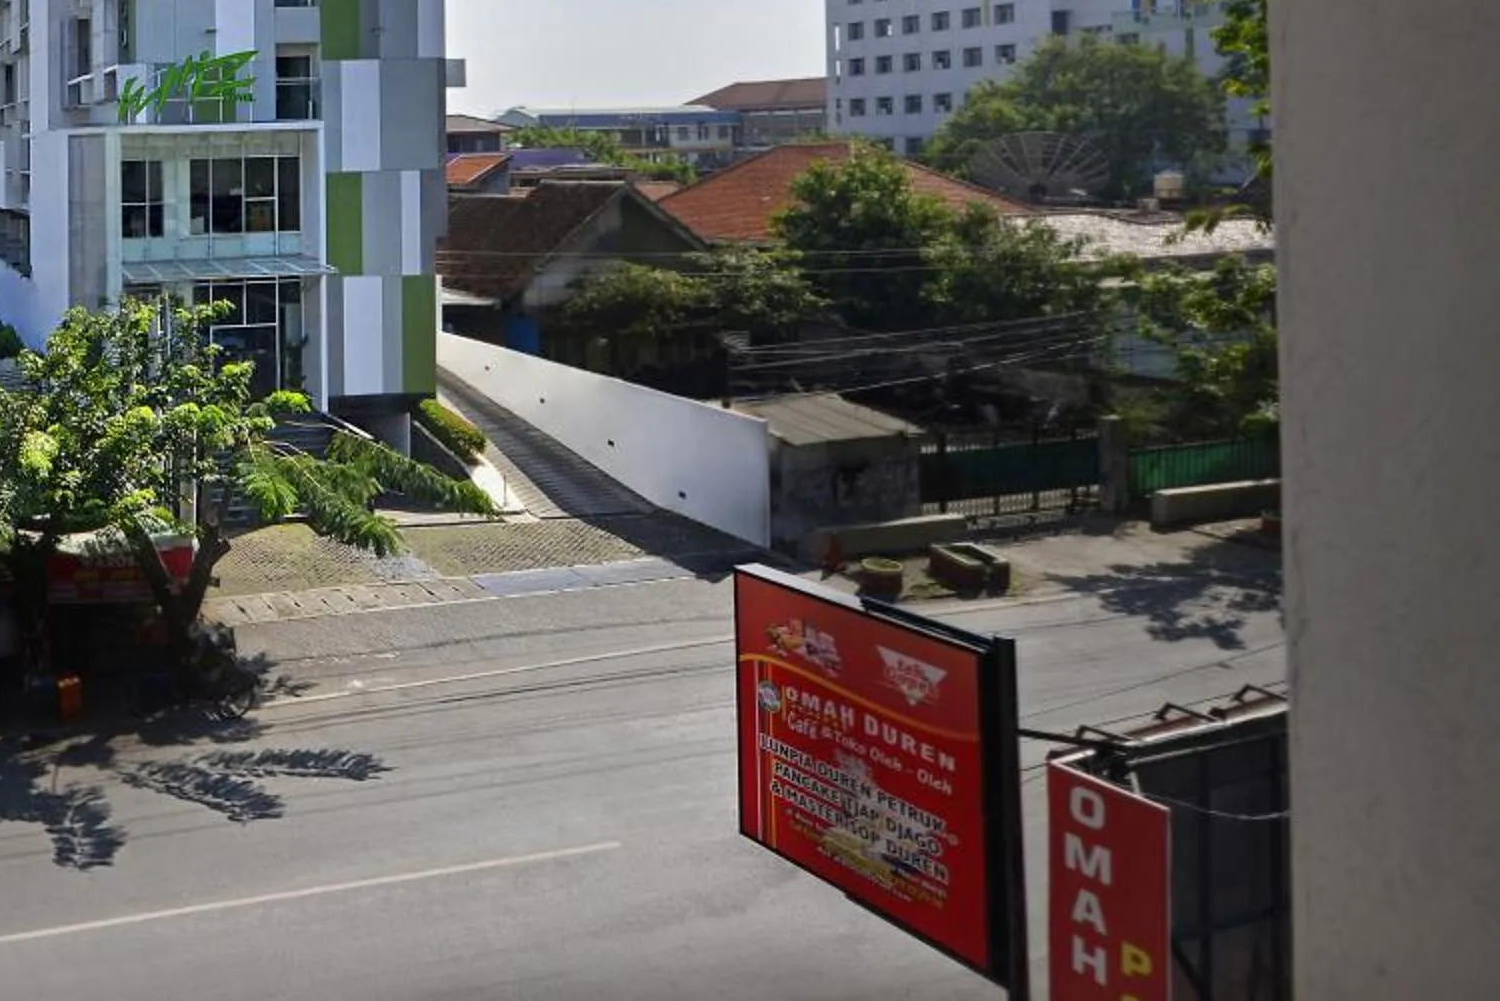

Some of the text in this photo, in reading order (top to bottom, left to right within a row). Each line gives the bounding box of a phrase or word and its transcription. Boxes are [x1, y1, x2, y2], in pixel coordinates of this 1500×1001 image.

[786, 686, 854, 727] OMAH
[864, 715, 956, 771] DUREN
[773, 760, 840, 803] PANCAKE
[916, 769, 952, 795] Oleh
[786, 787, 842, 827] MASTER
[886, 838, 947, 885] DUREN
[1064, 787, 1112, 986] OMAH
